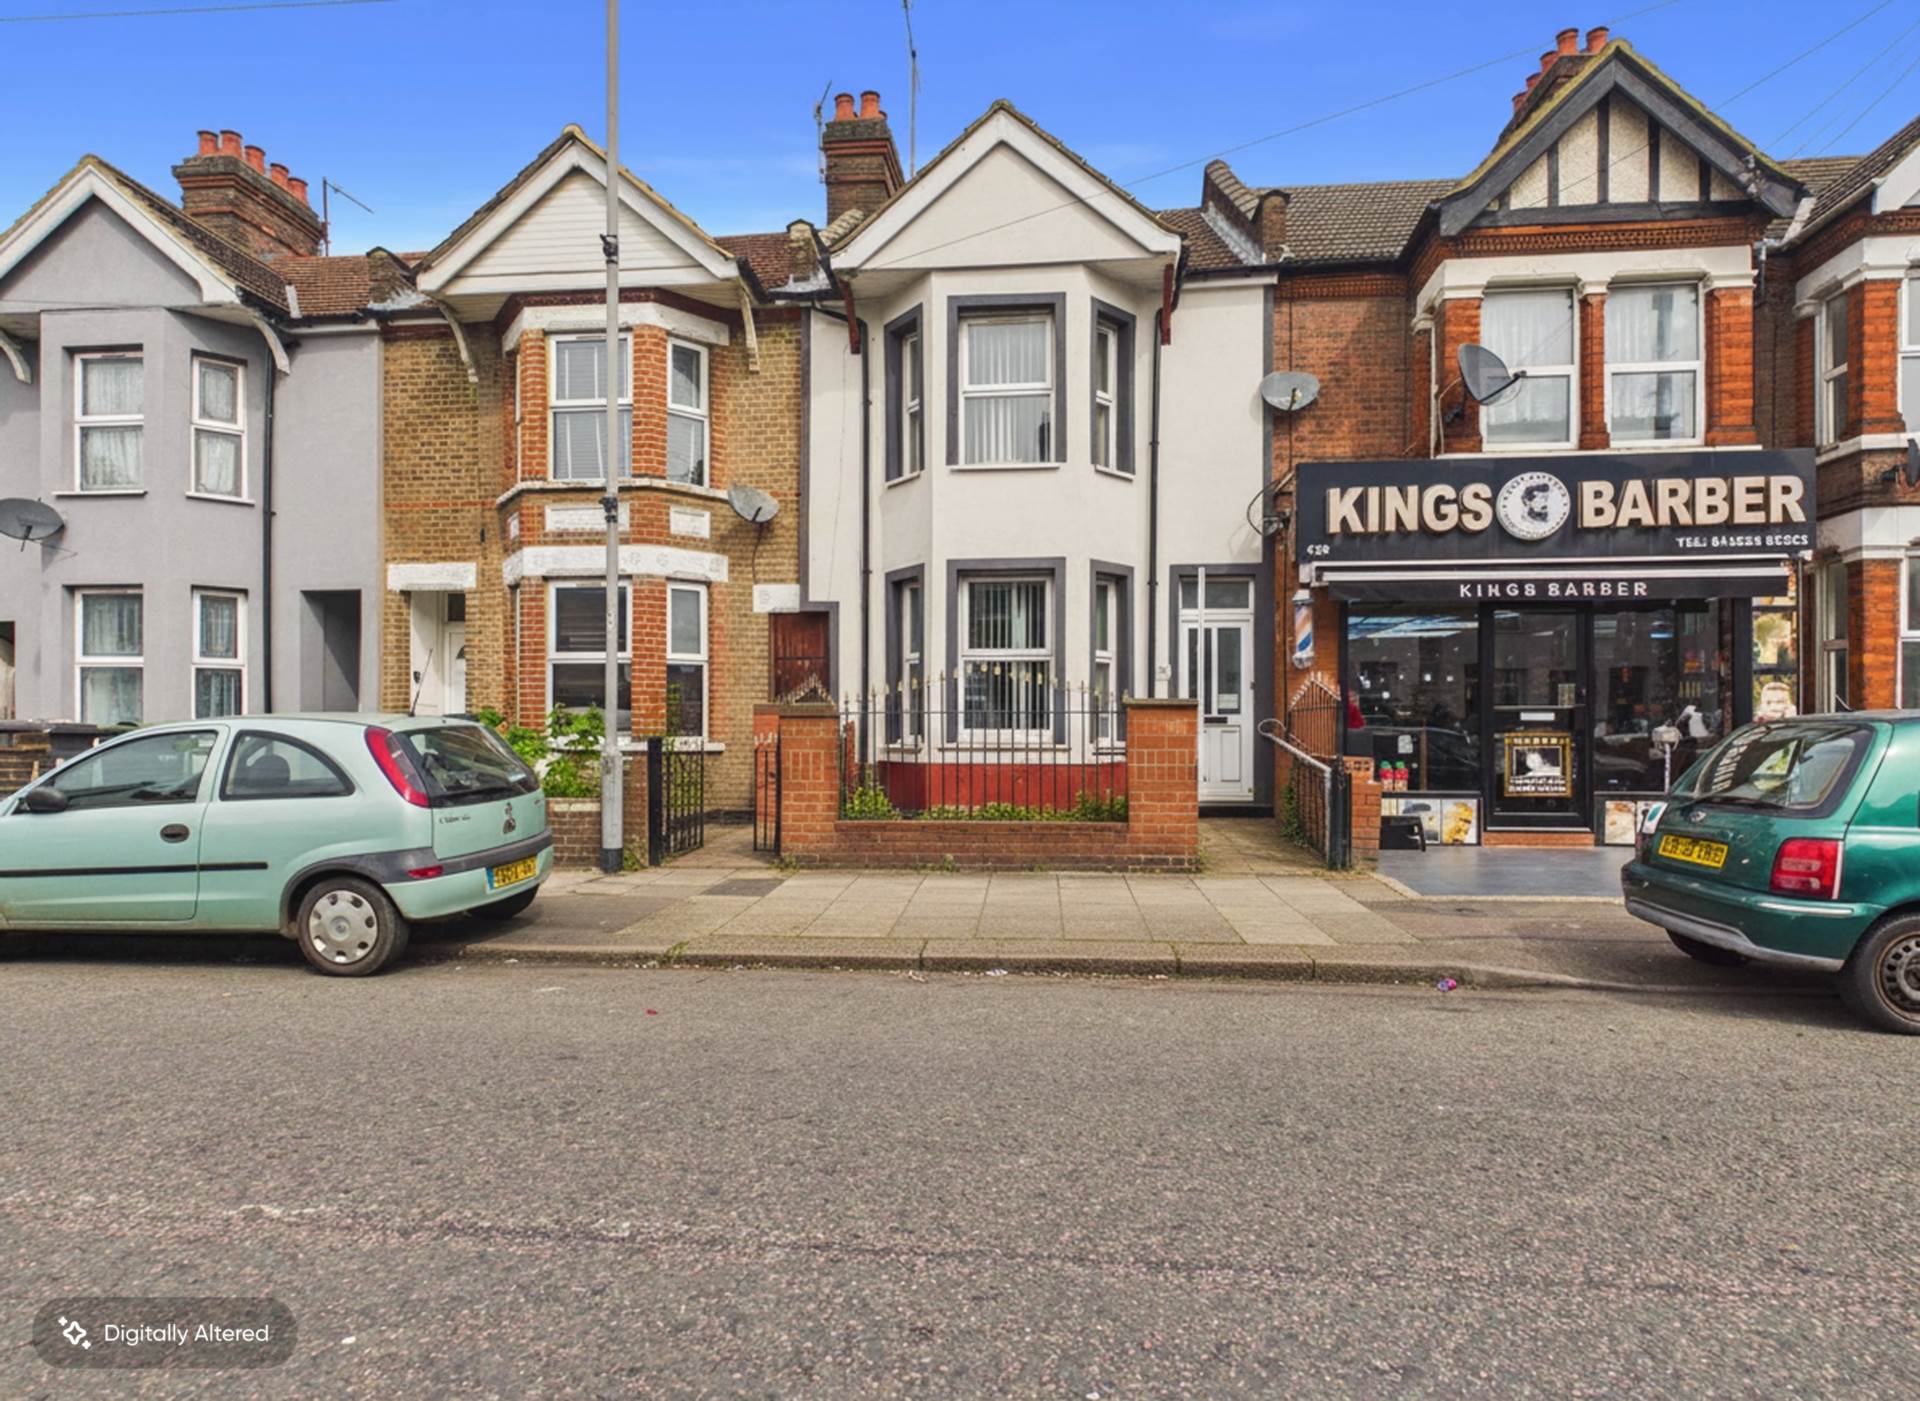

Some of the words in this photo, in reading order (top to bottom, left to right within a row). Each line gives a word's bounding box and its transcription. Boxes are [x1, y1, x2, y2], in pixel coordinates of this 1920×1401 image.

[1327, 483, 1494, 533] KINGS
[1578, 475, 1807, 528] BARBER
[1459, 583, 1536, 598] KINGS
[1548, 581, 1648, 597] BARBER
